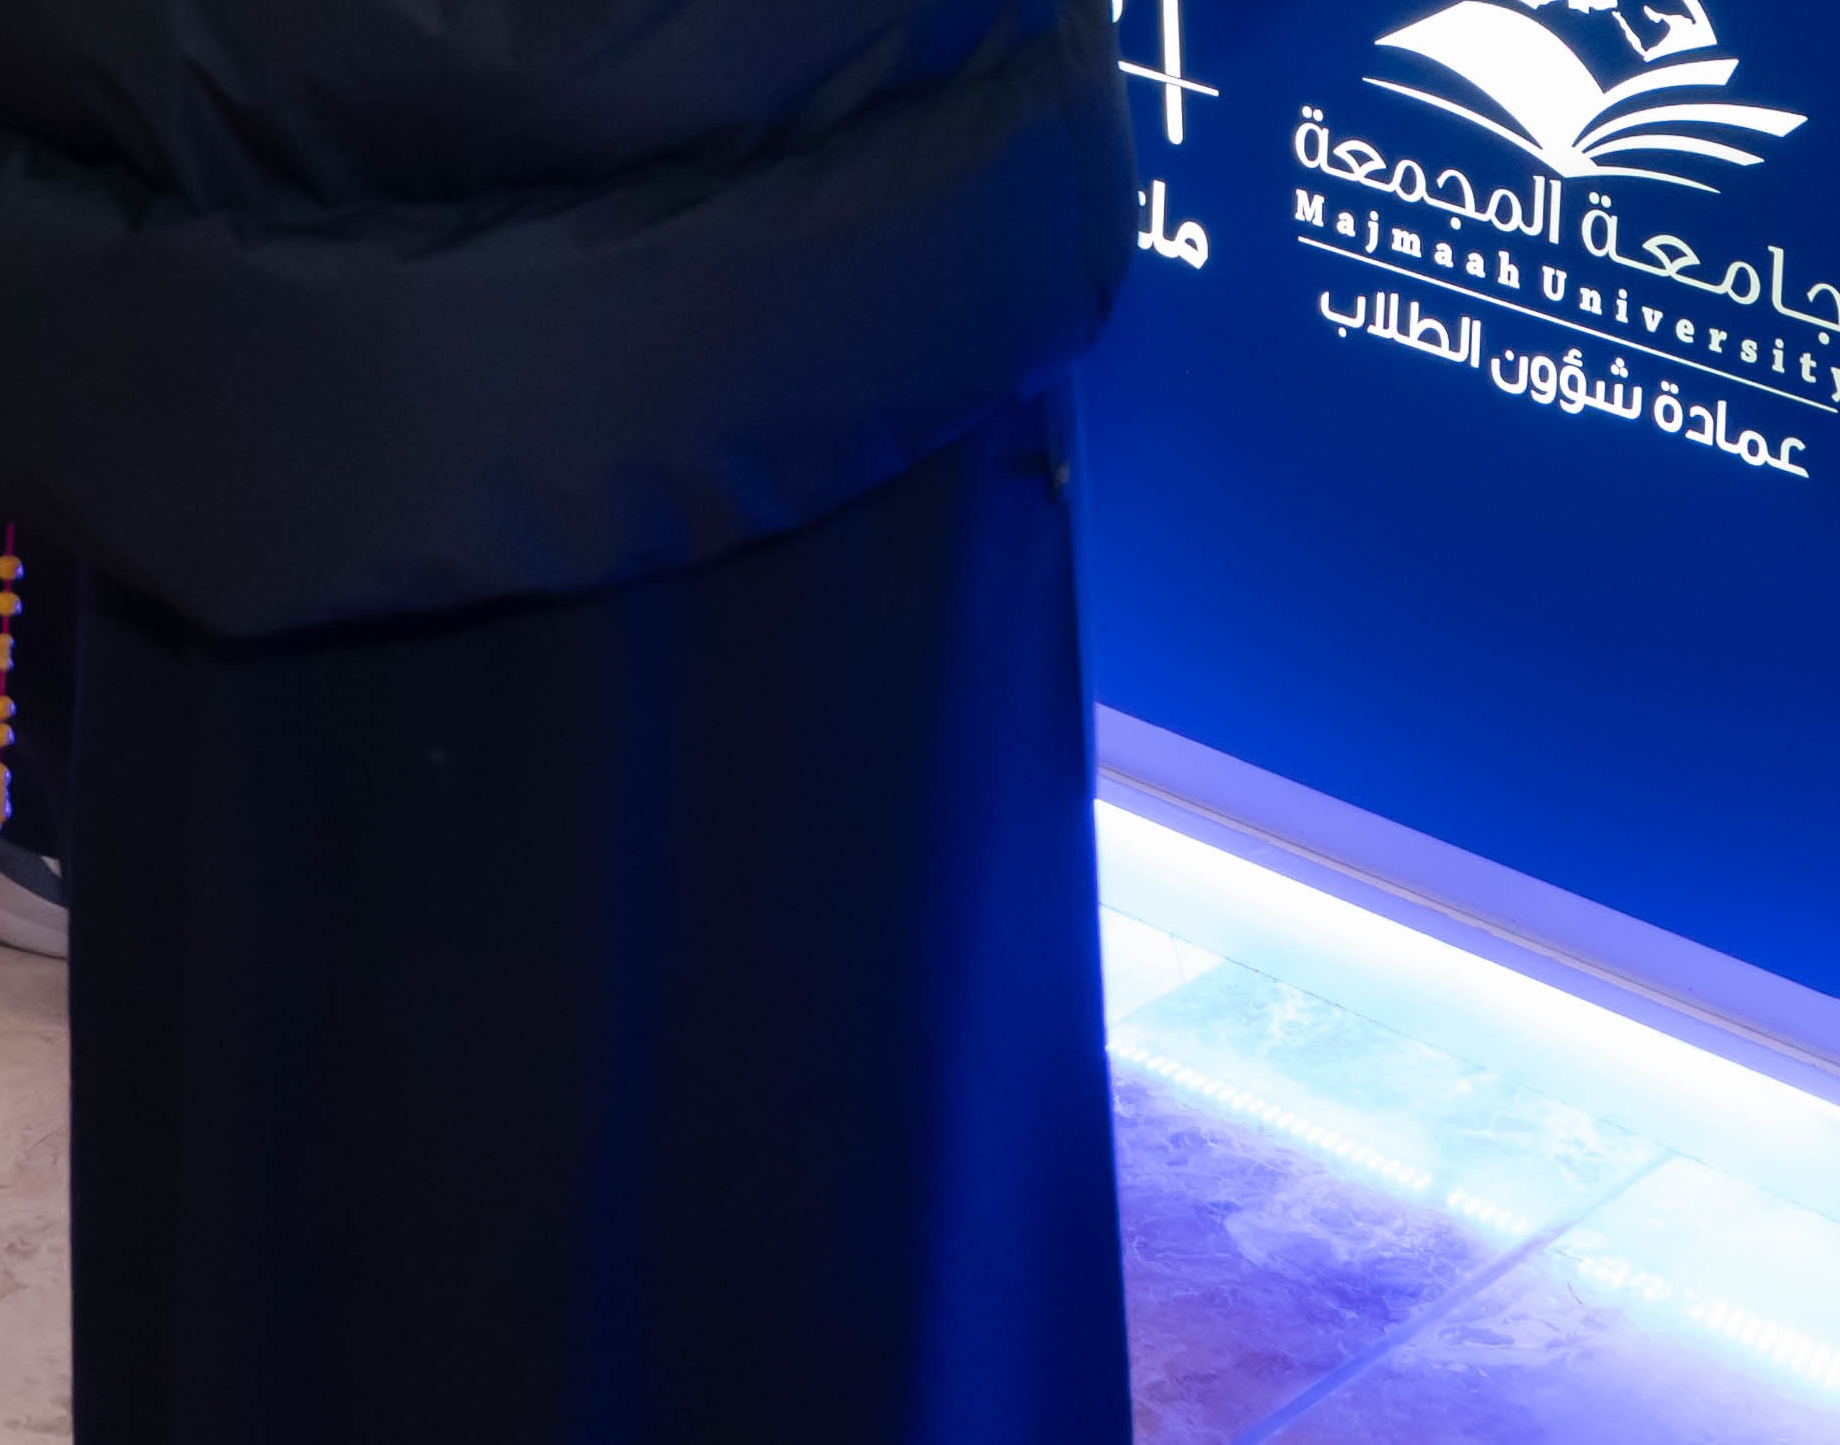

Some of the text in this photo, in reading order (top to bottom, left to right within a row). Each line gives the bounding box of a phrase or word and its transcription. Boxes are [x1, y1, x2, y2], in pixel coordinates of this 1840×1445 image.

[1294, 105, 1561, 246] المجمعة
[1294, 188, 1521, 291] Majmaah
[1320, 289, 1811, 479] عمادة شؤون الطلاب
